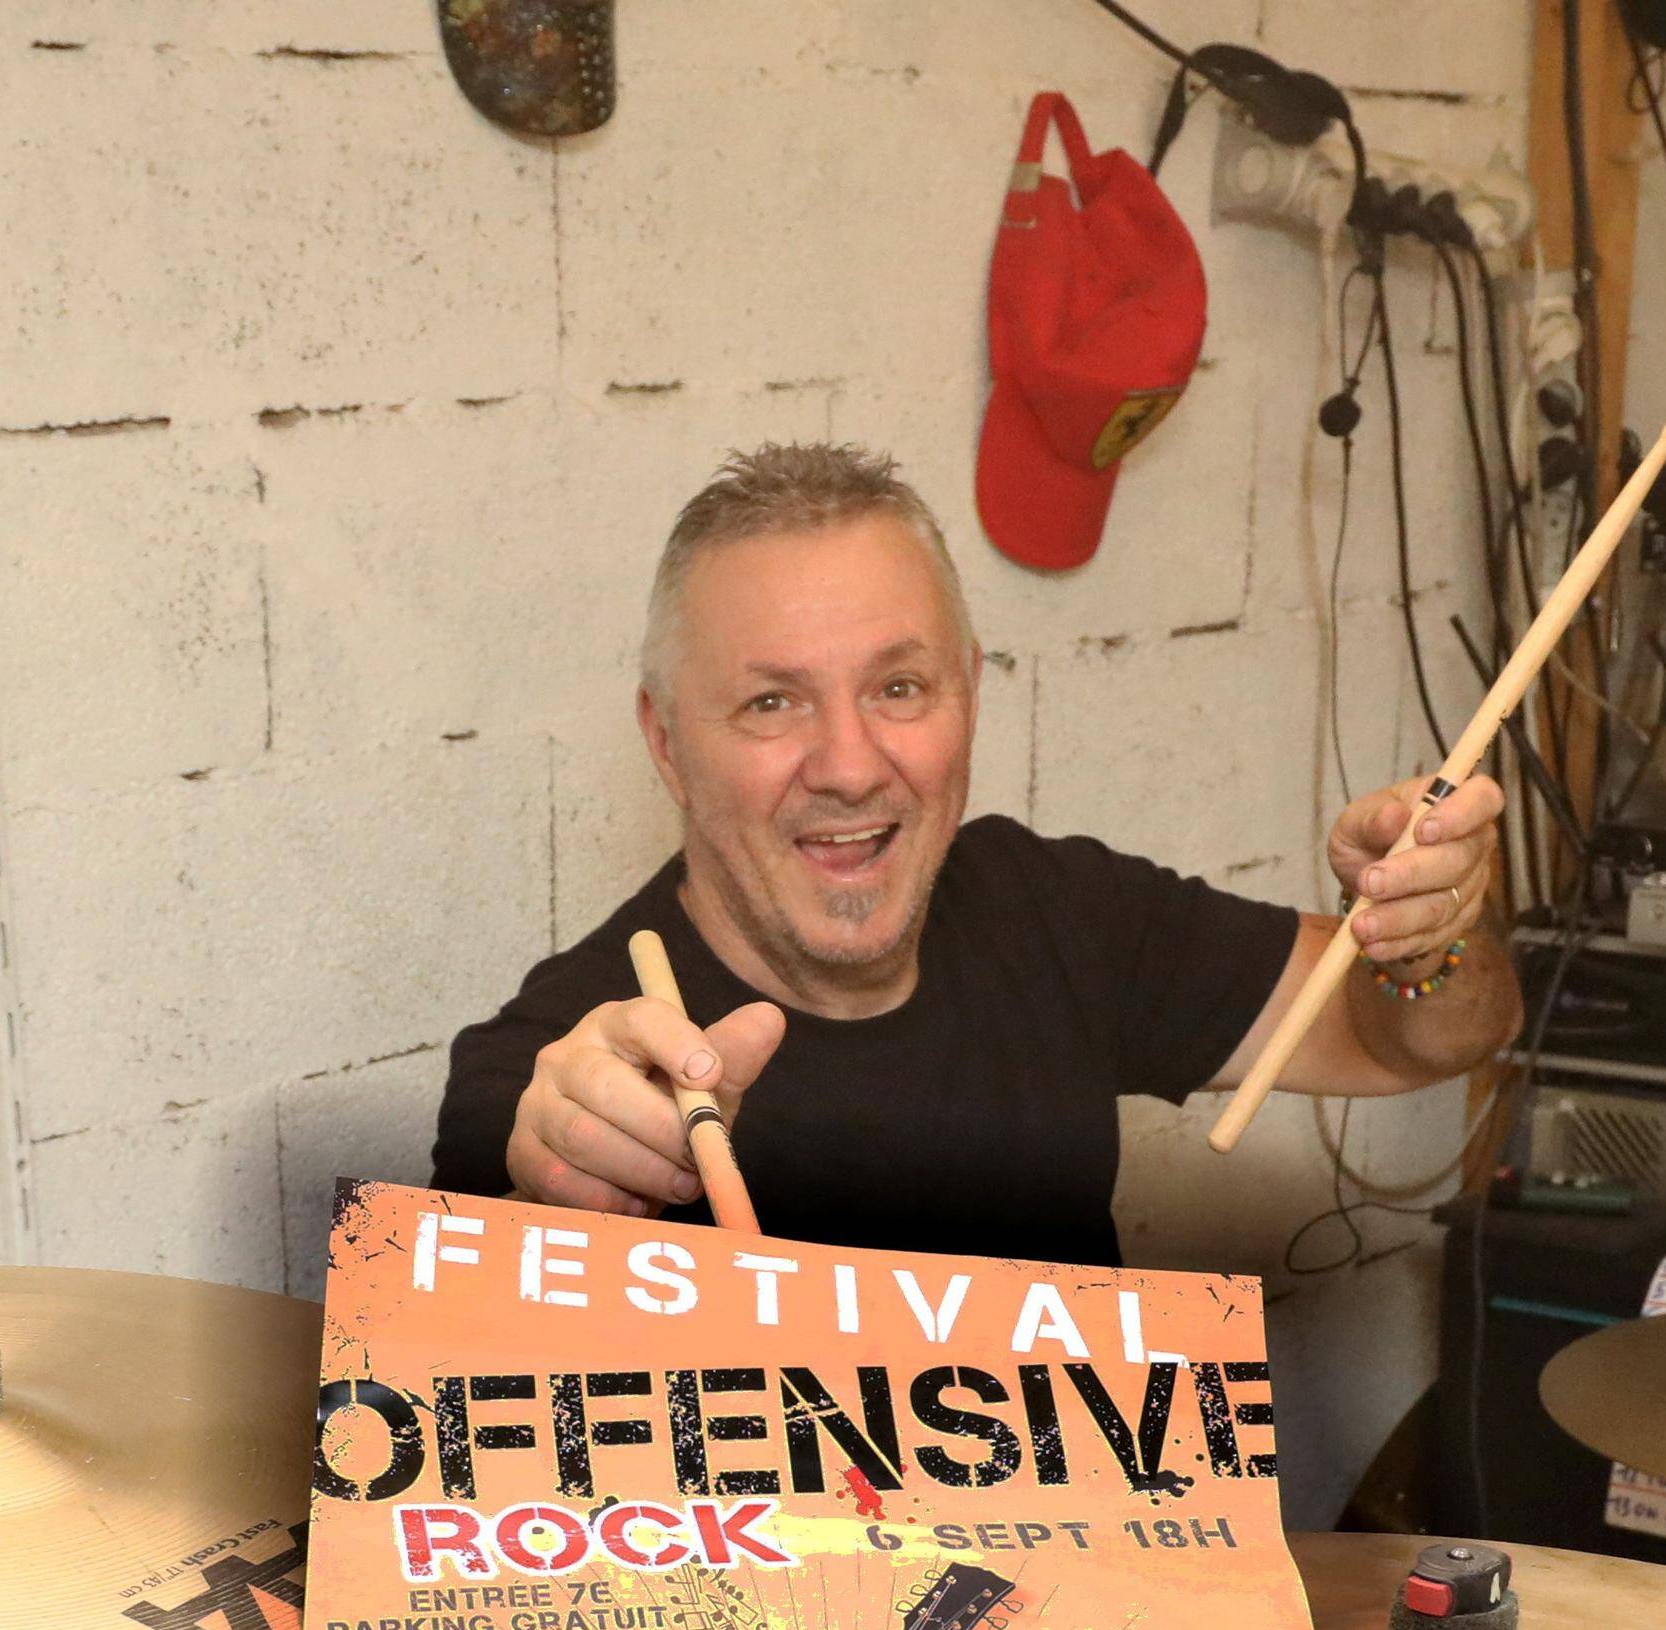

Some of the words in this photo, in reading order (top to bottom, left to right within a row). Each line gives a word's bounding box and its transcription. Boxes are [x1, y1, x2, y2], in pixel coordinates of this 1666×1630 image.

[413, 1211, 1192, 1368] FESTIVAL
[312, 1360, 1277, 1505] OFFENSIVE
[239, 1518, 281, 1542] Fast
[399, 1502, 795, 1582] ROCK
[867, 1521, 903, 1553] 6
[924, 1520, 1092, 1554] SEPT
[1122, 1518, 1239, 1550] 18H
[181, 1536, 237, 1567] Crash
[409, 1578, 553, 1613] ENTRÉE
